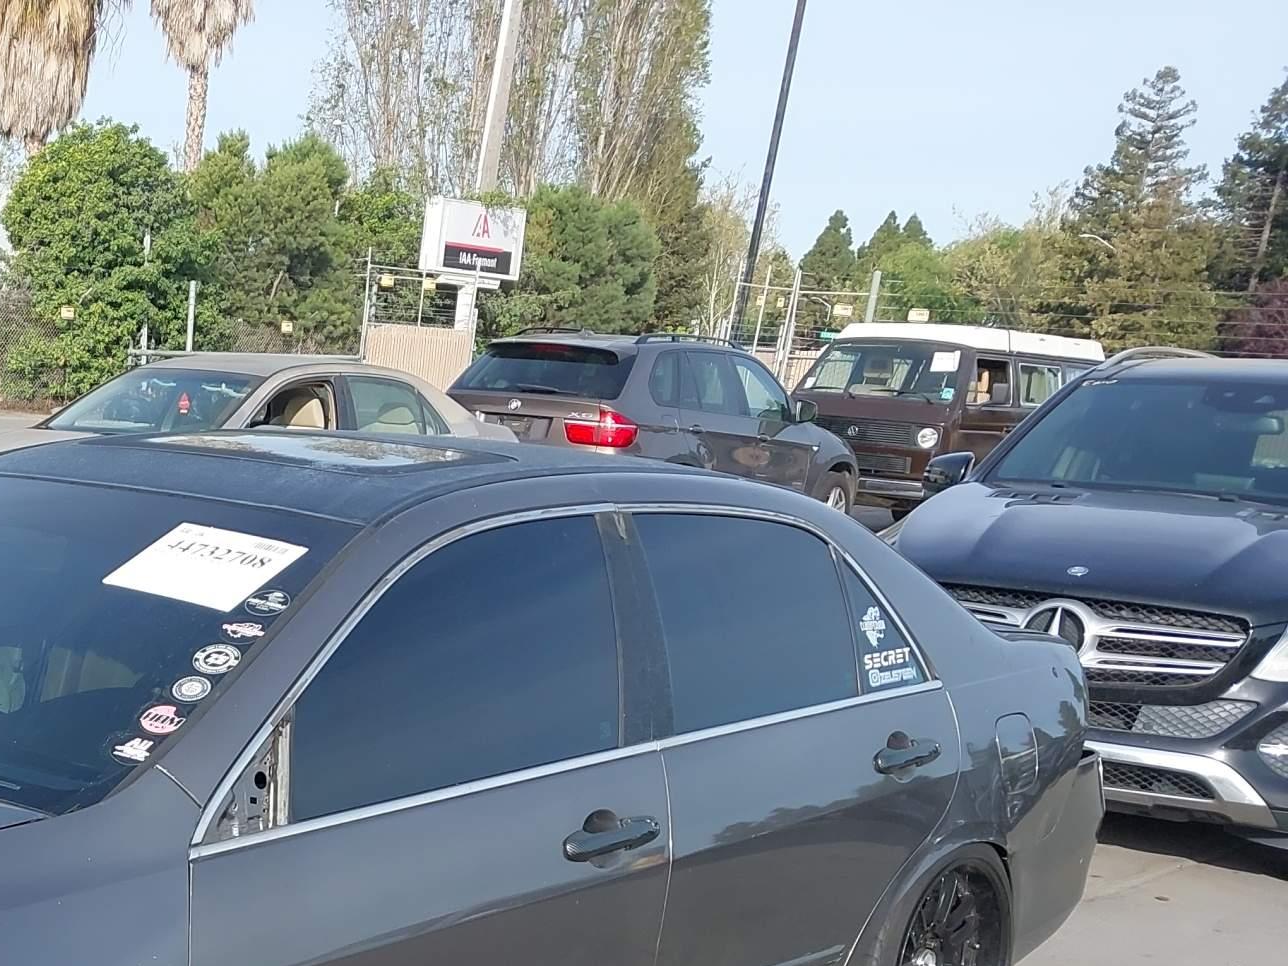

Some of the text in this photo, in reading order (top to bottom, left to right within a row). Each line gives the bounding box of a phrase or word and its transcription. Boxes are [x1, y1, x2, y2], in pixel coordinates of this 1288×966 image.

[459, 251, 471, 265] IAA
[167, 540, 272, 568] 44732708
[864, 647, 911, 670] SECRET
